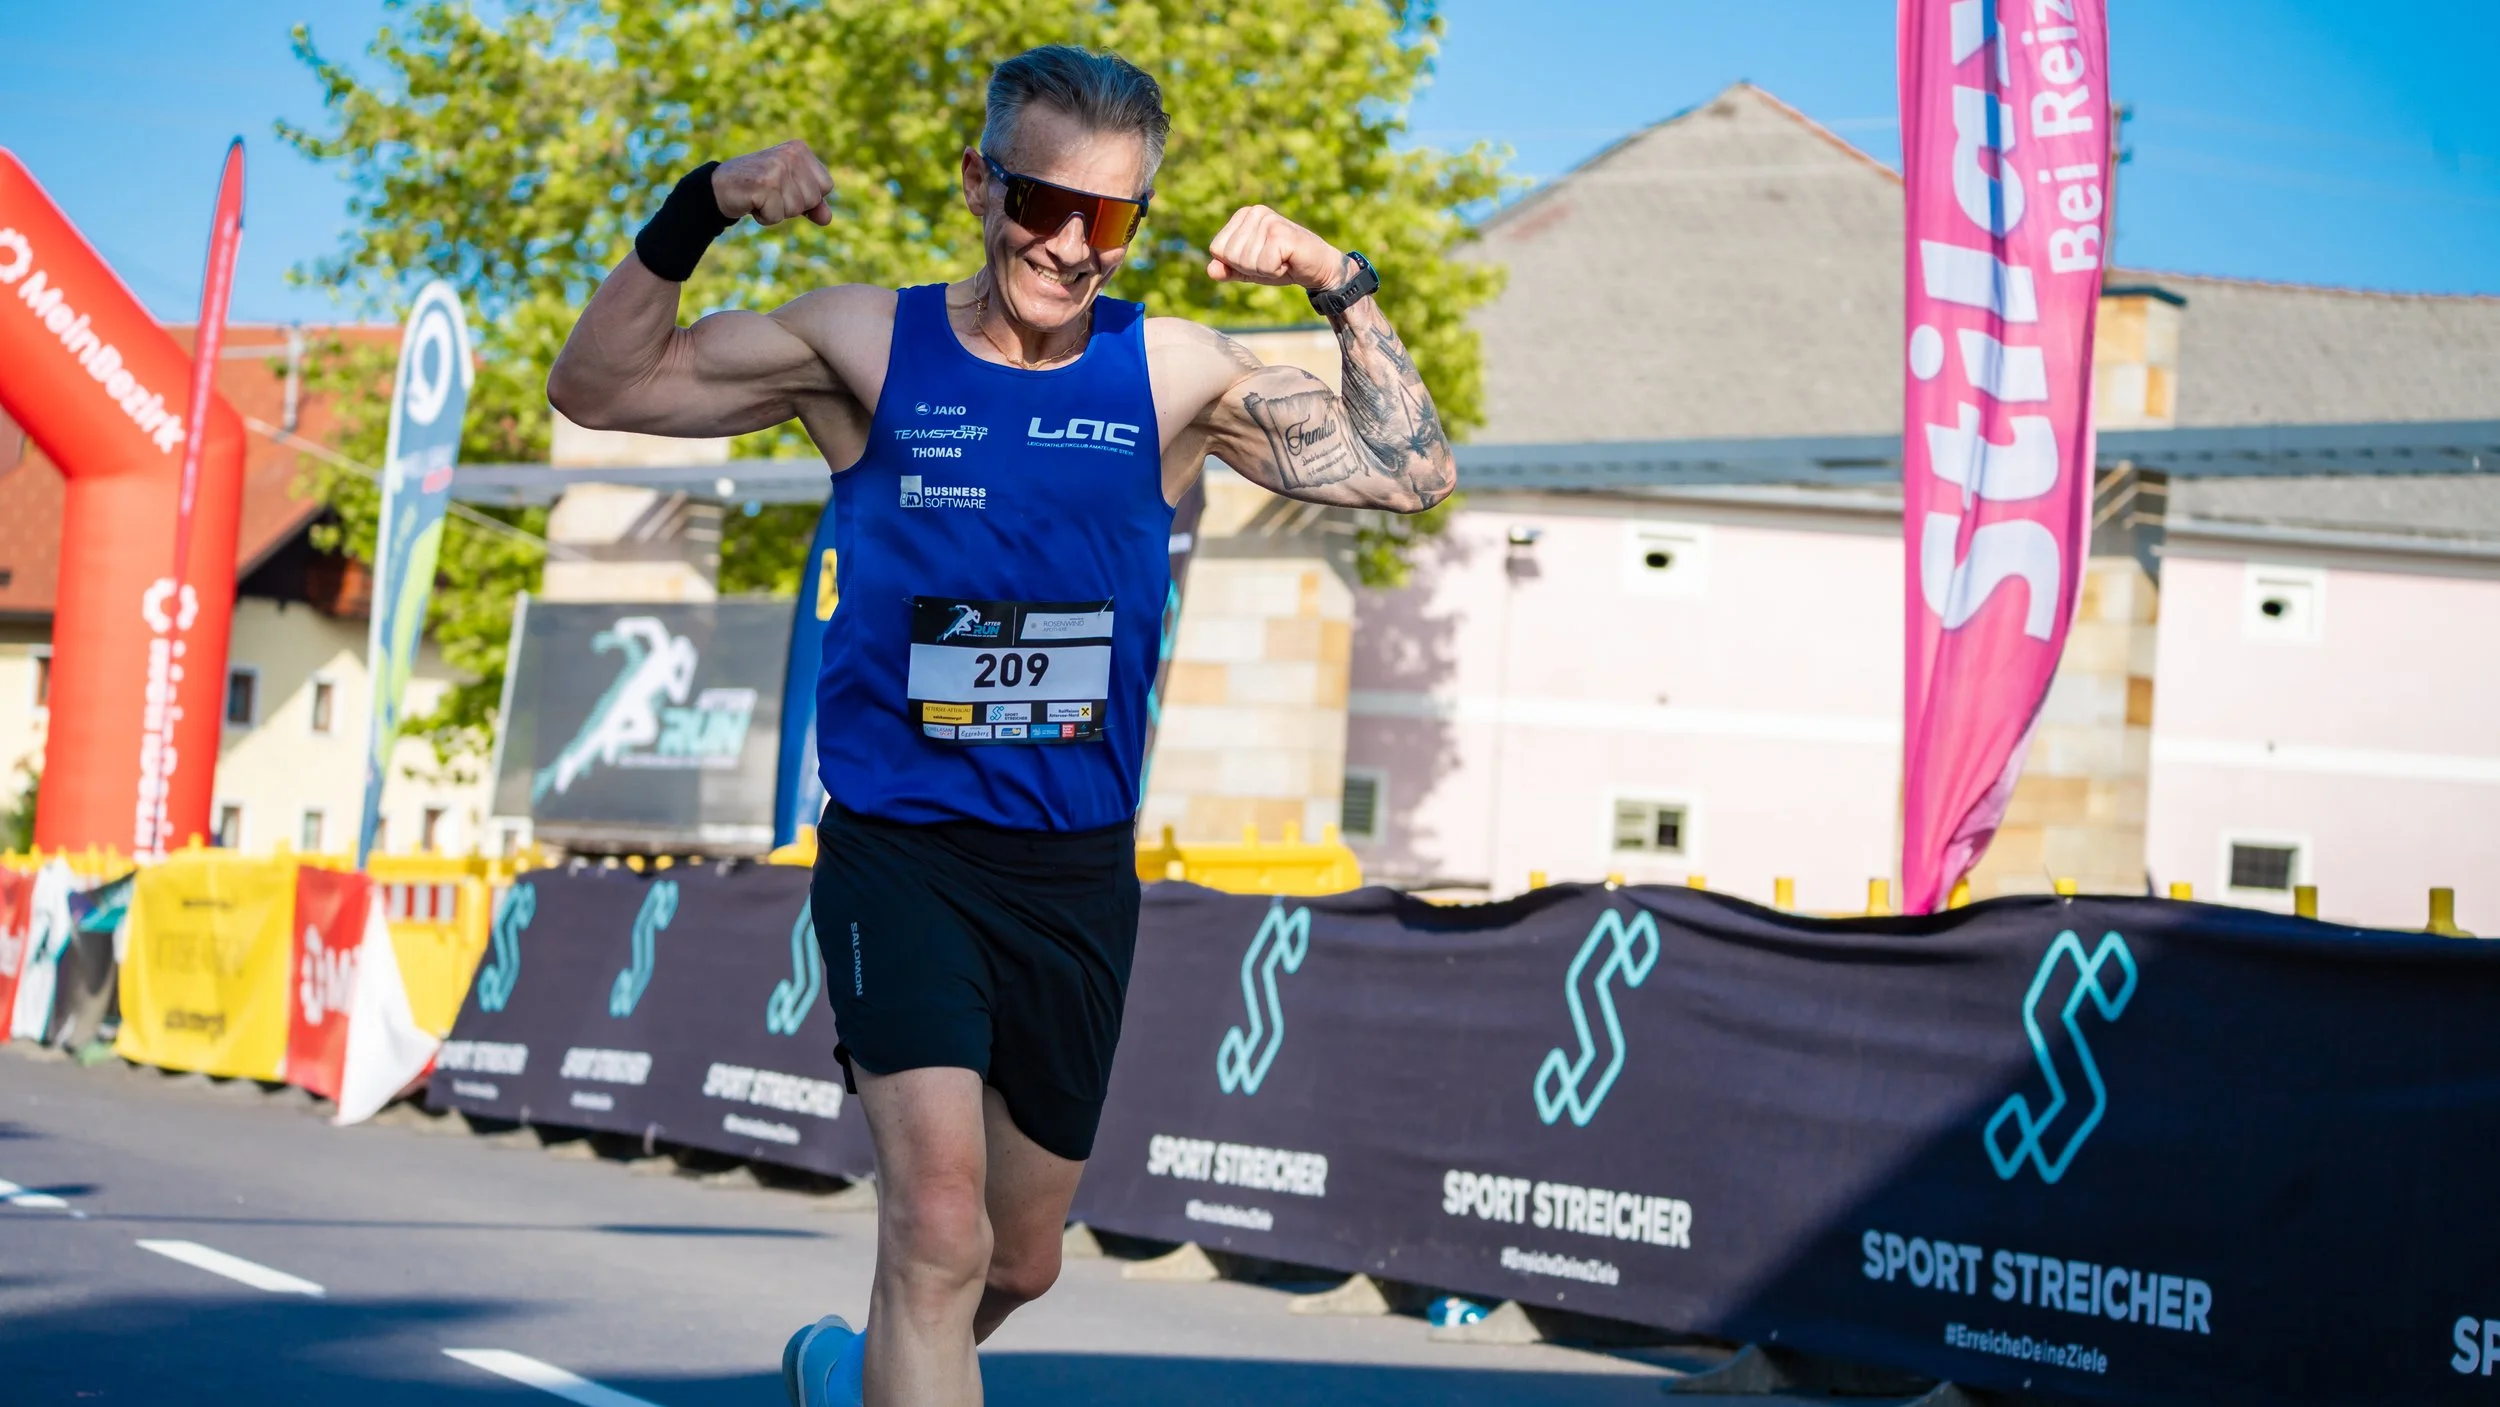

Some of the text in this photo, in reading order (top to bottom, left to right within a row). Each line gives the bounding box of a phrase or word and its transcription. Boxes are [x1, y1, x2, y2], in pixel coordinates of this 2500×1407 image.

[2037, 162, 2101, 274] Bei
[17, 269, 187, 455] MeinBezirk
[932, 406, 967, 416] JAKO
[960, 425, 988, 433] STEYR
[894, 429, 988, 441] TEAMSPORT
[911, 447, 962, 458] THOMAS
[924, 486, 987, 498] BUSINESS
[924, 498, 987, 510] SOFTWARE
[972, 625, 1000, 635] RUN
[973, 652, 1050, 689] 209
[850, 921, 863, 997] SALOMON
[1147, 1134, 1328, 1197] SPORT STREICHER
[1442, 1169, 1692, 1249] SPORT STREICHER
[1862, 1229, 2212, 1335] SPORT STREICHER
[1944, 1322, 2108, 1374] #ErreicheDeineZiele
